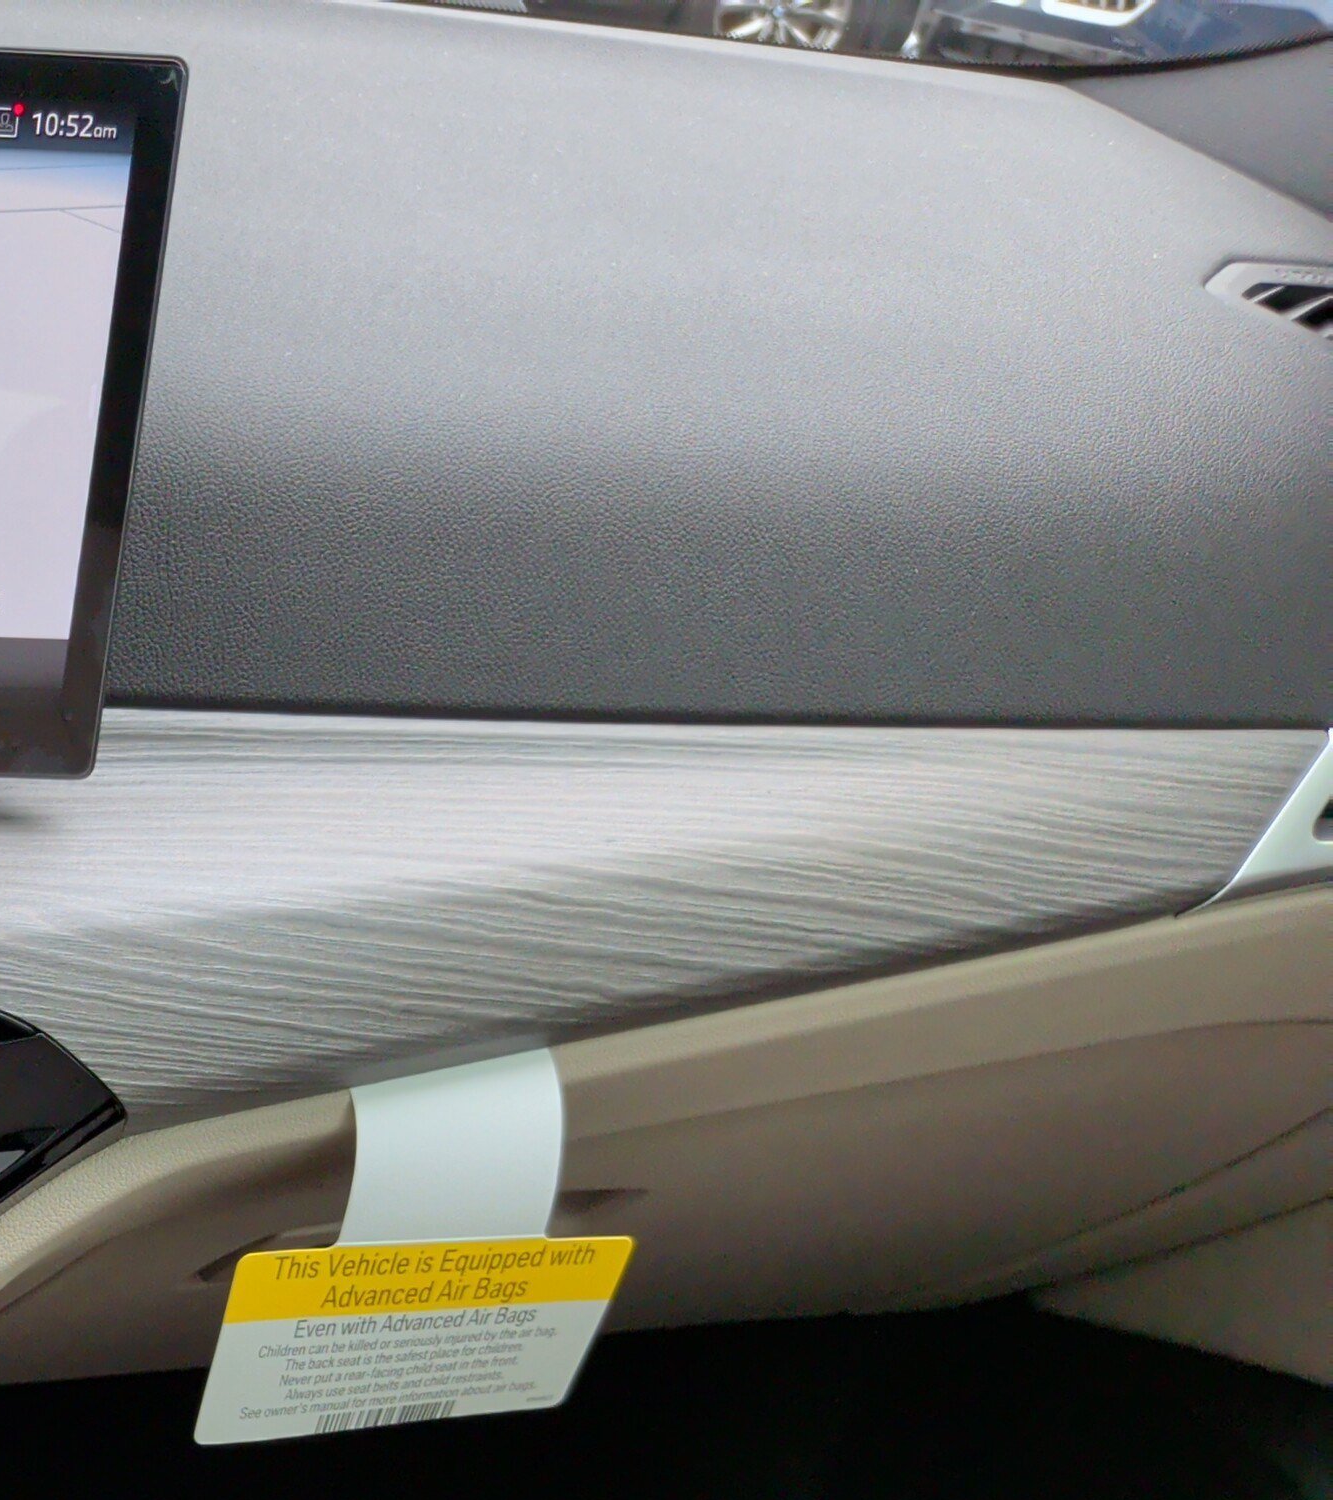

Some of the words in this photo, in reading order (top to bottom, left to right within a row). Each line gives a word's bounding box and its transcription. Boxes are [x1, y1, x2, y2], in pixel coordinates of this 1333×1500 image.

[32, 112, 118, 140] 10:52am
[275, 1255, 320, 1281] This
[329, 1253, 410, 1277] Vehicle
[415, 1251, 433, 1273] is
[440, 1245, 545, 1275] Equipped
[549, 1243, 595, 1267] with
[320, 1280, 434, 1309] Advanced
[436, 1279, 470, 1302] Air
[474, 1278, 528, 1306] Bags
[294, 1319, 336, 1339] Even
[341, 1316, 376, 1332] with
[380, 1309, 467, 1334] Advanced
[467, 1309, 493, 1326] Air
[494, 1307, 537, 1327] Bags
[258, 1344, 306, 1359] Children
[308, 1344, 331, 1355] can
[332, 1341, 346, 1353] be
[348, 1338, 377, 1351] killed
[394, 1334, 442, 1350] seriously
[499, 1328, 518, 1340] the
[279, 1374, 312, 1387] Never
[313, 1371, 333, 1385] put
[344, 1364, 404, 1382] rear-facing
[405, 1362, 433, 1375] child
[434, 1360, 458, 1372] seat
[471, 1357, 489, 1368] the
[285, 1358, 306, 1371] The
[308, 1356, 334, 1369] back
[336, 1354, 361, 1367] seat
[374, 1352, 393, 1364] the
[395, 1348, 432, 1363] safest
[240, 1406, 262, 1420] See
[264, 1402, 308, 1417] owner's
[309, 1398, 350, 1412] manual
[352, 1396, 367, 1409] for
[368, 1394, 397, 1406] more
[398, 1386, 460, 1403] information
[285, 1387, 323, 1401] Always
[325, 1385, 345, 1397] use
[348, 1382, 371, 1395] seat
[401, 1378, 421, 1390] and
